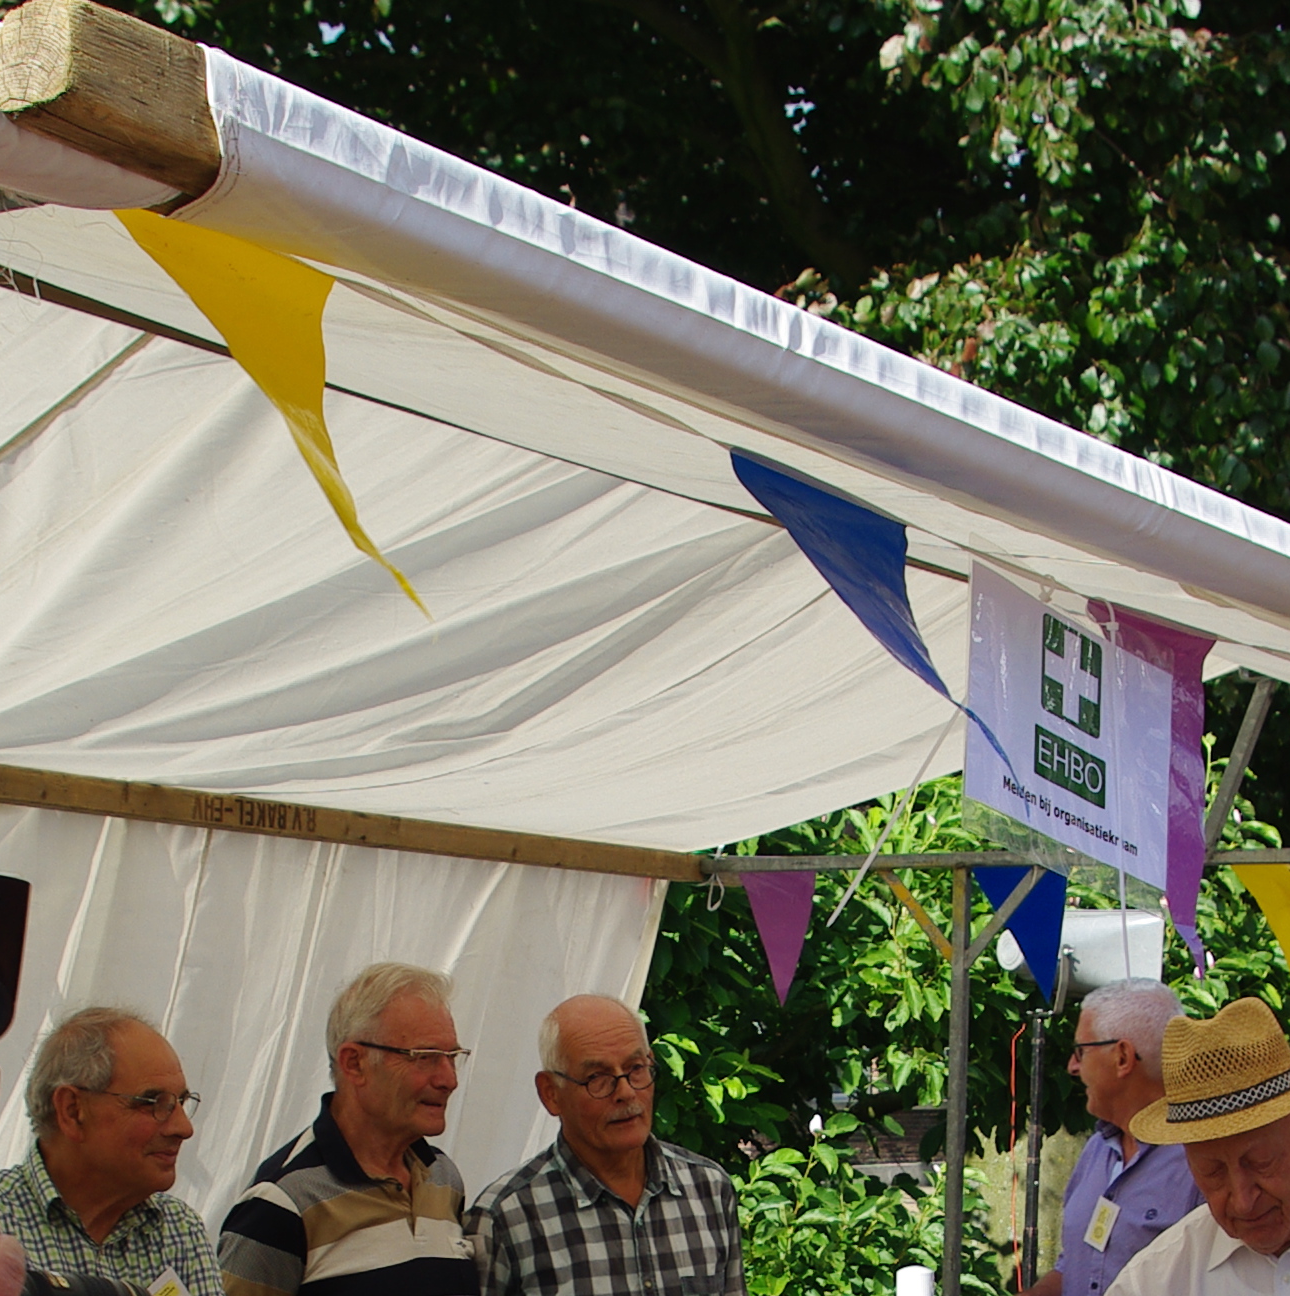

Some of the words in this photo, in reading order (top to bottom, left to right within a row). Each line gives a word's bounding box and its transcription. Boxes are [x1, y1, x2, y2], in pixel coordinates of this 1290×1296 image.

[1037, 735, 1104, 794] EHBO
[1040, 795, 1051, 817] bij
[1054, 806, 1138, 856] organisatiekram
